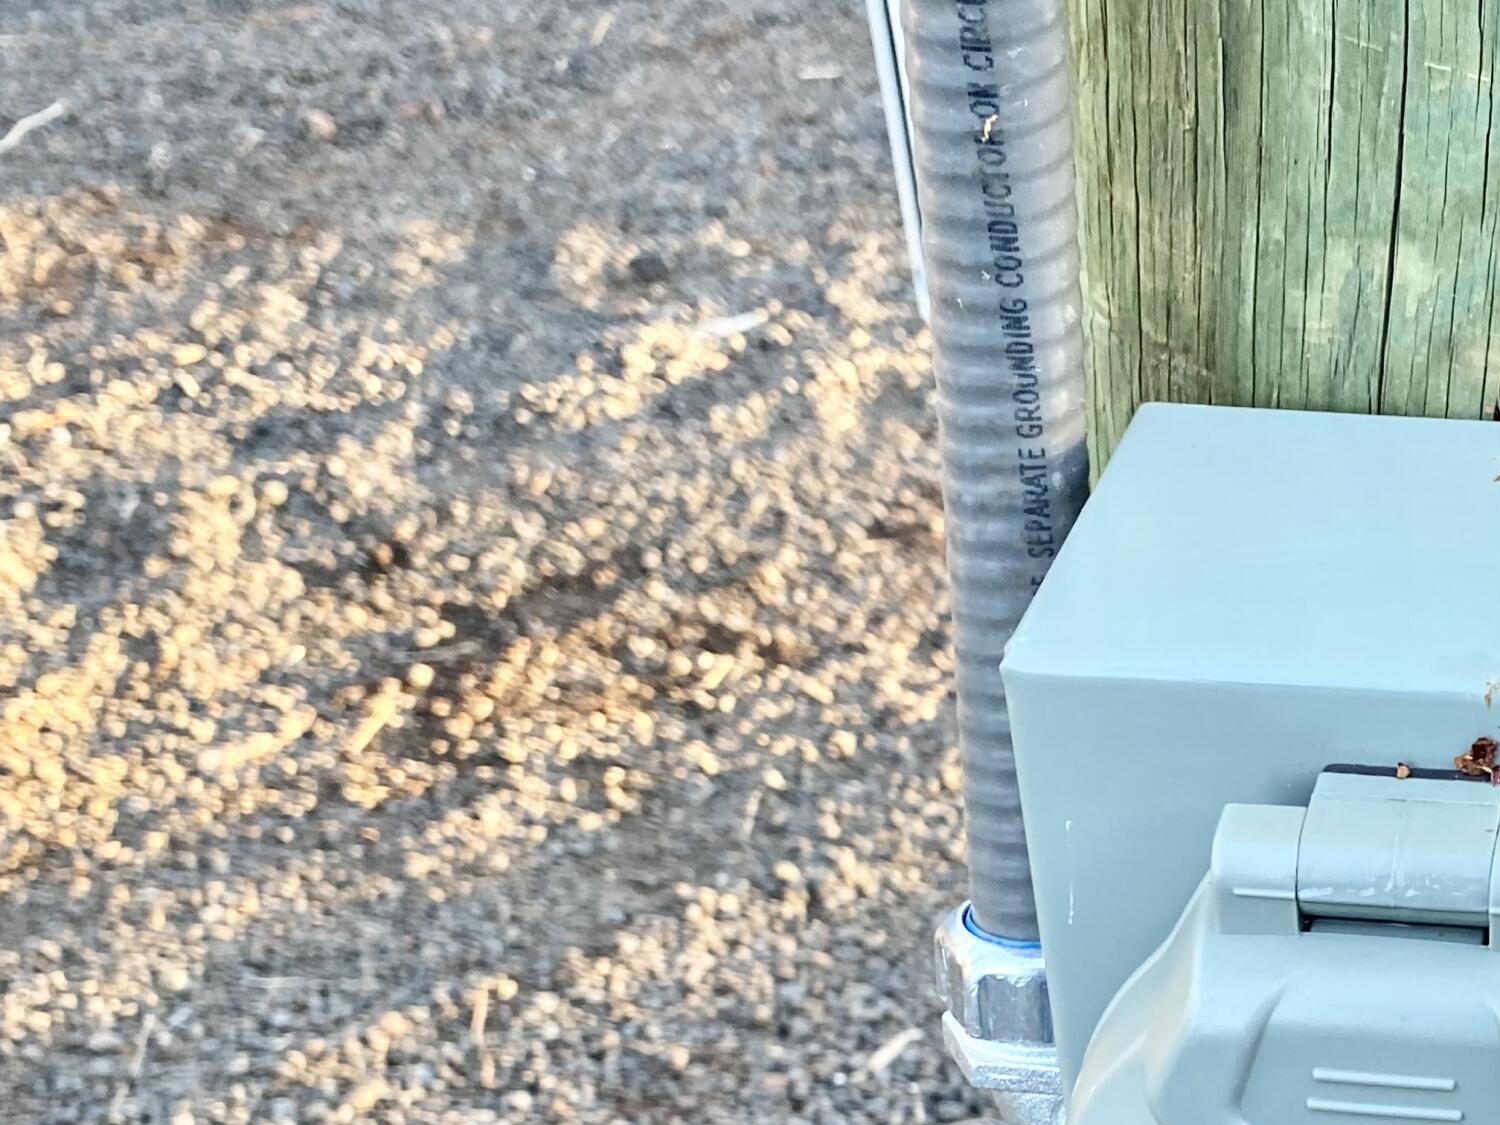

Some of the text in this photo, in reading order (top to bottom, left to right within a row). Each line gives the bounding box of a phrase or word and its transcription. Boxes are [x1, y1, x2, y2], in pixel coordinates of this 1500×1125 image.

[974, 128, 1024, 288] CONDUCTOR
[1000, 297, 1044, 439] GROUNDING
[1018, 448, 1054, 559] SEPARATE
